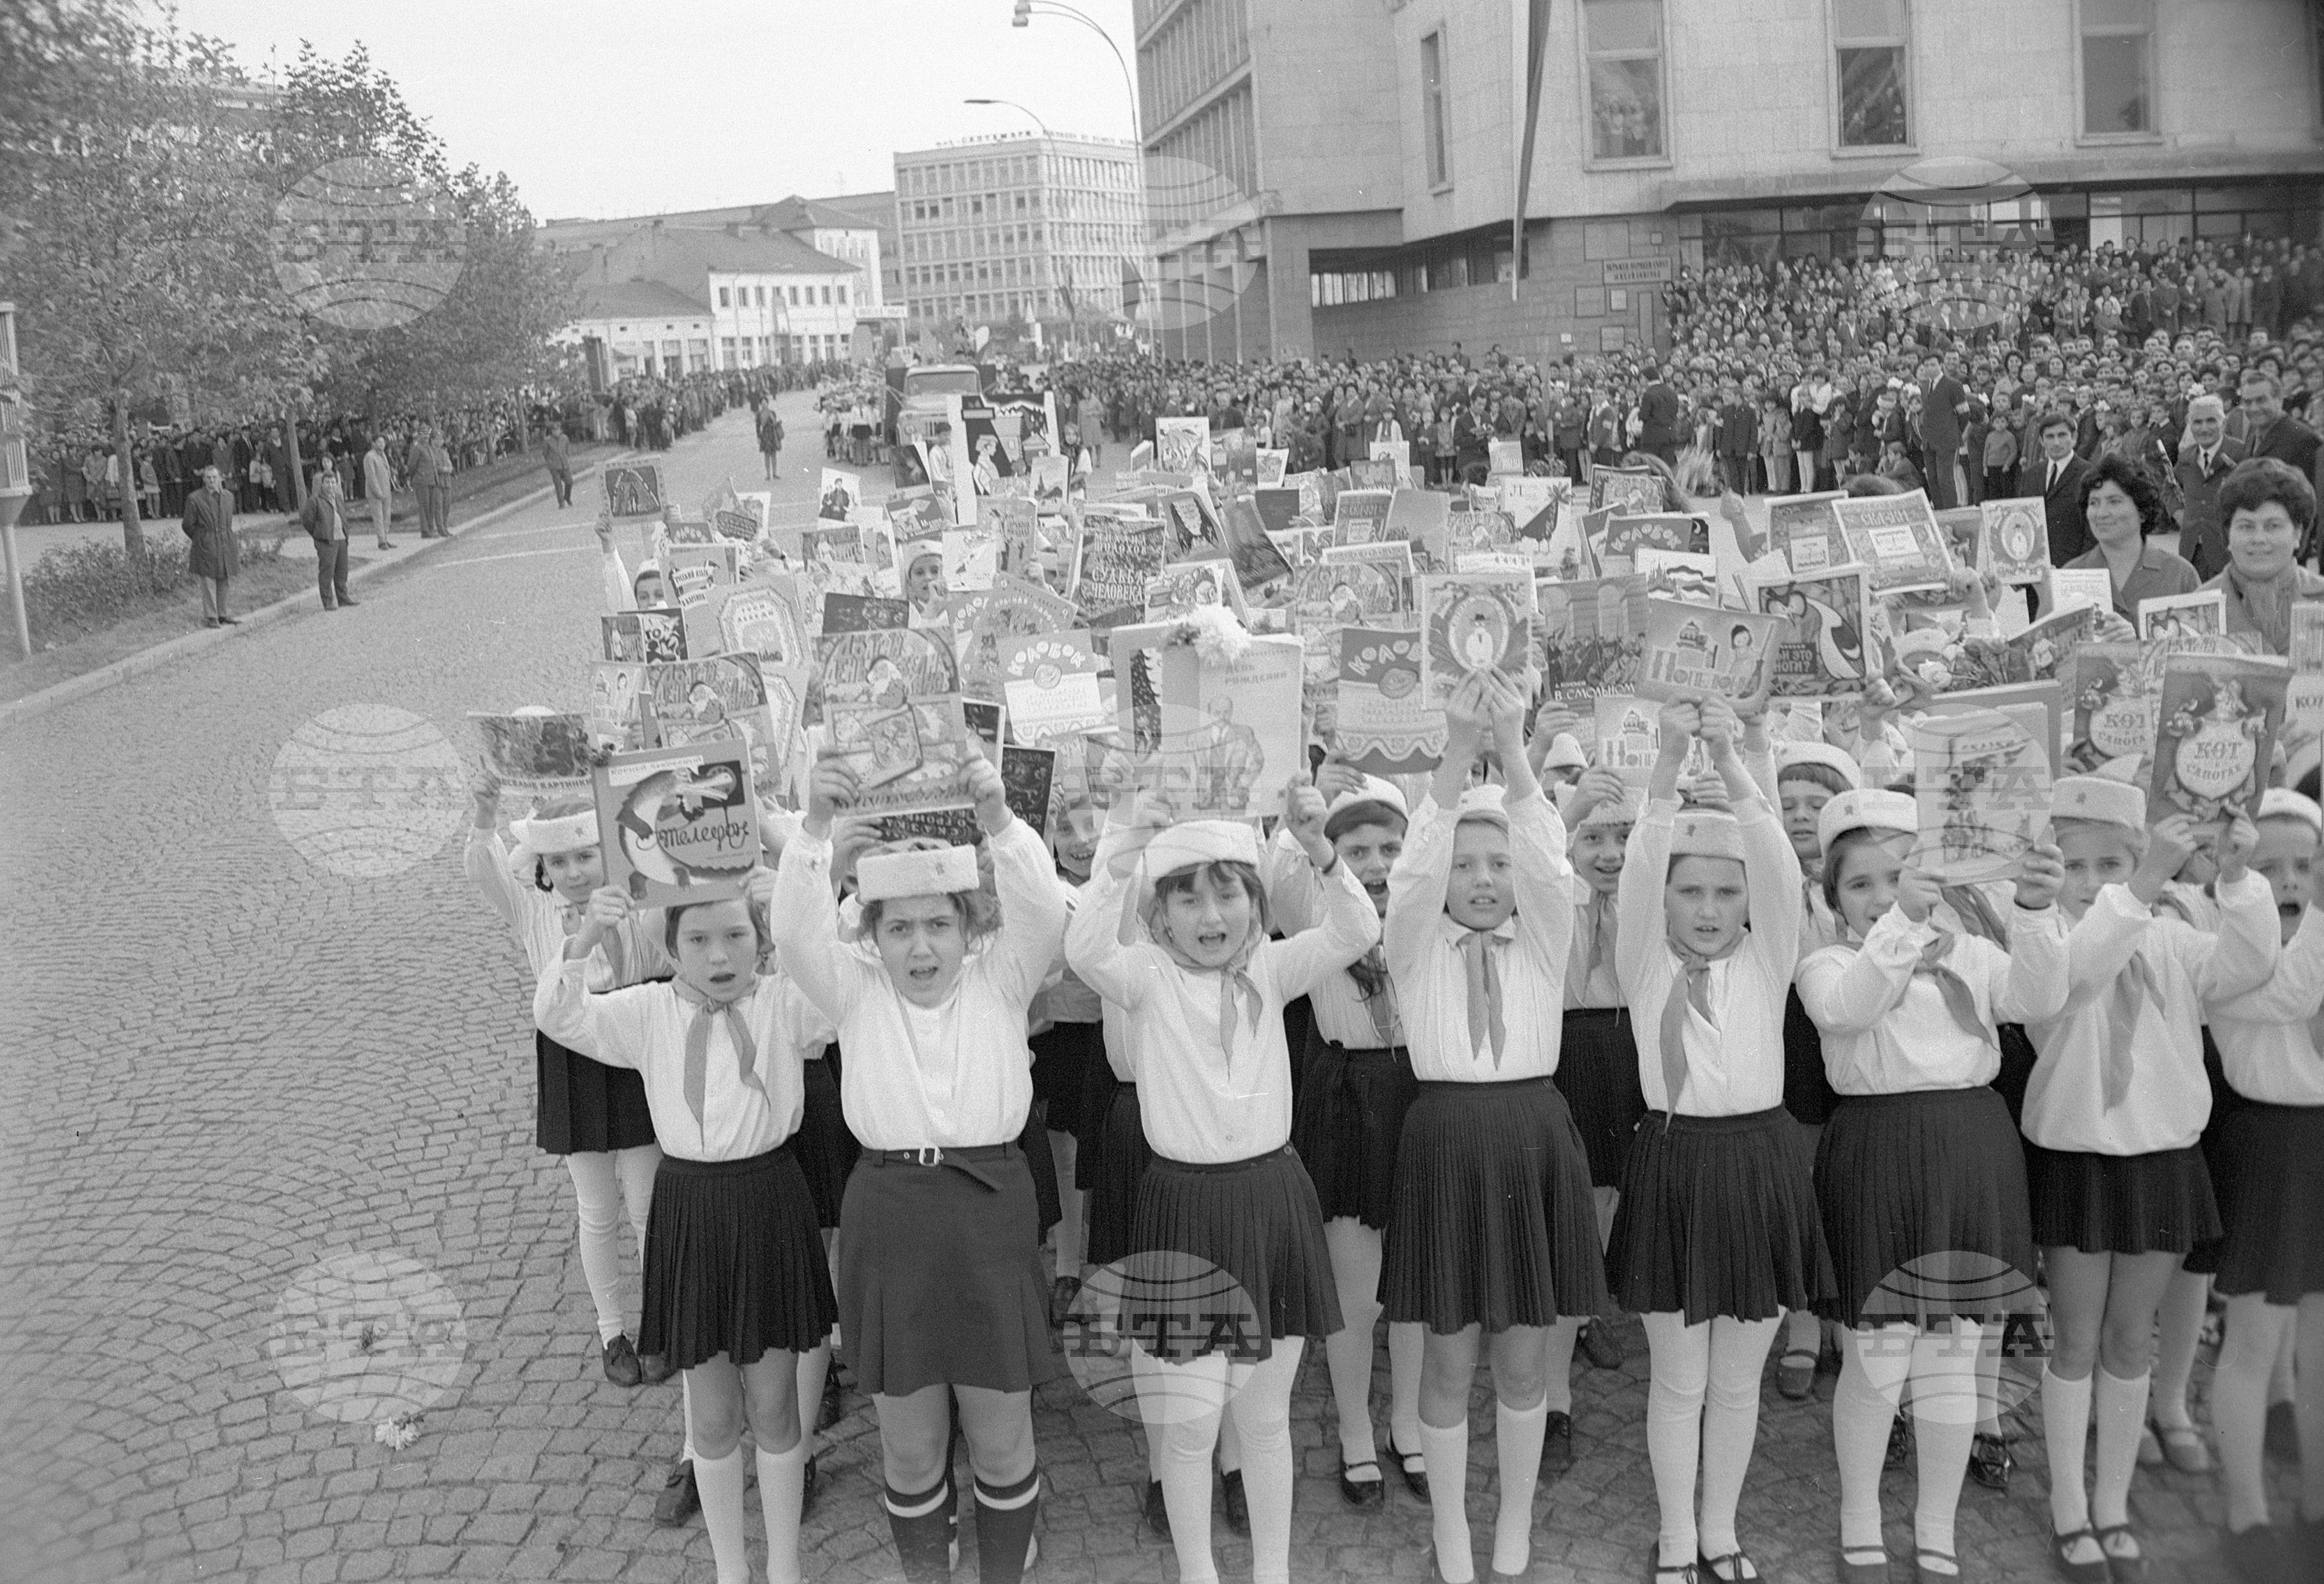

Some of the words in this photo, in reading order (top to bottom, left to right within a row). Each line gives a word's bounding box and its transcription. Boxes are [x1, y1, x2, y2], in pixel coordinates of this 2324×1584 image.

[1092, 568, 1144, 586] СУДЬБА
[1007, 640, 1086, 676] КОЛОБОК
[2193, 741, 2243, 760] КОТ
